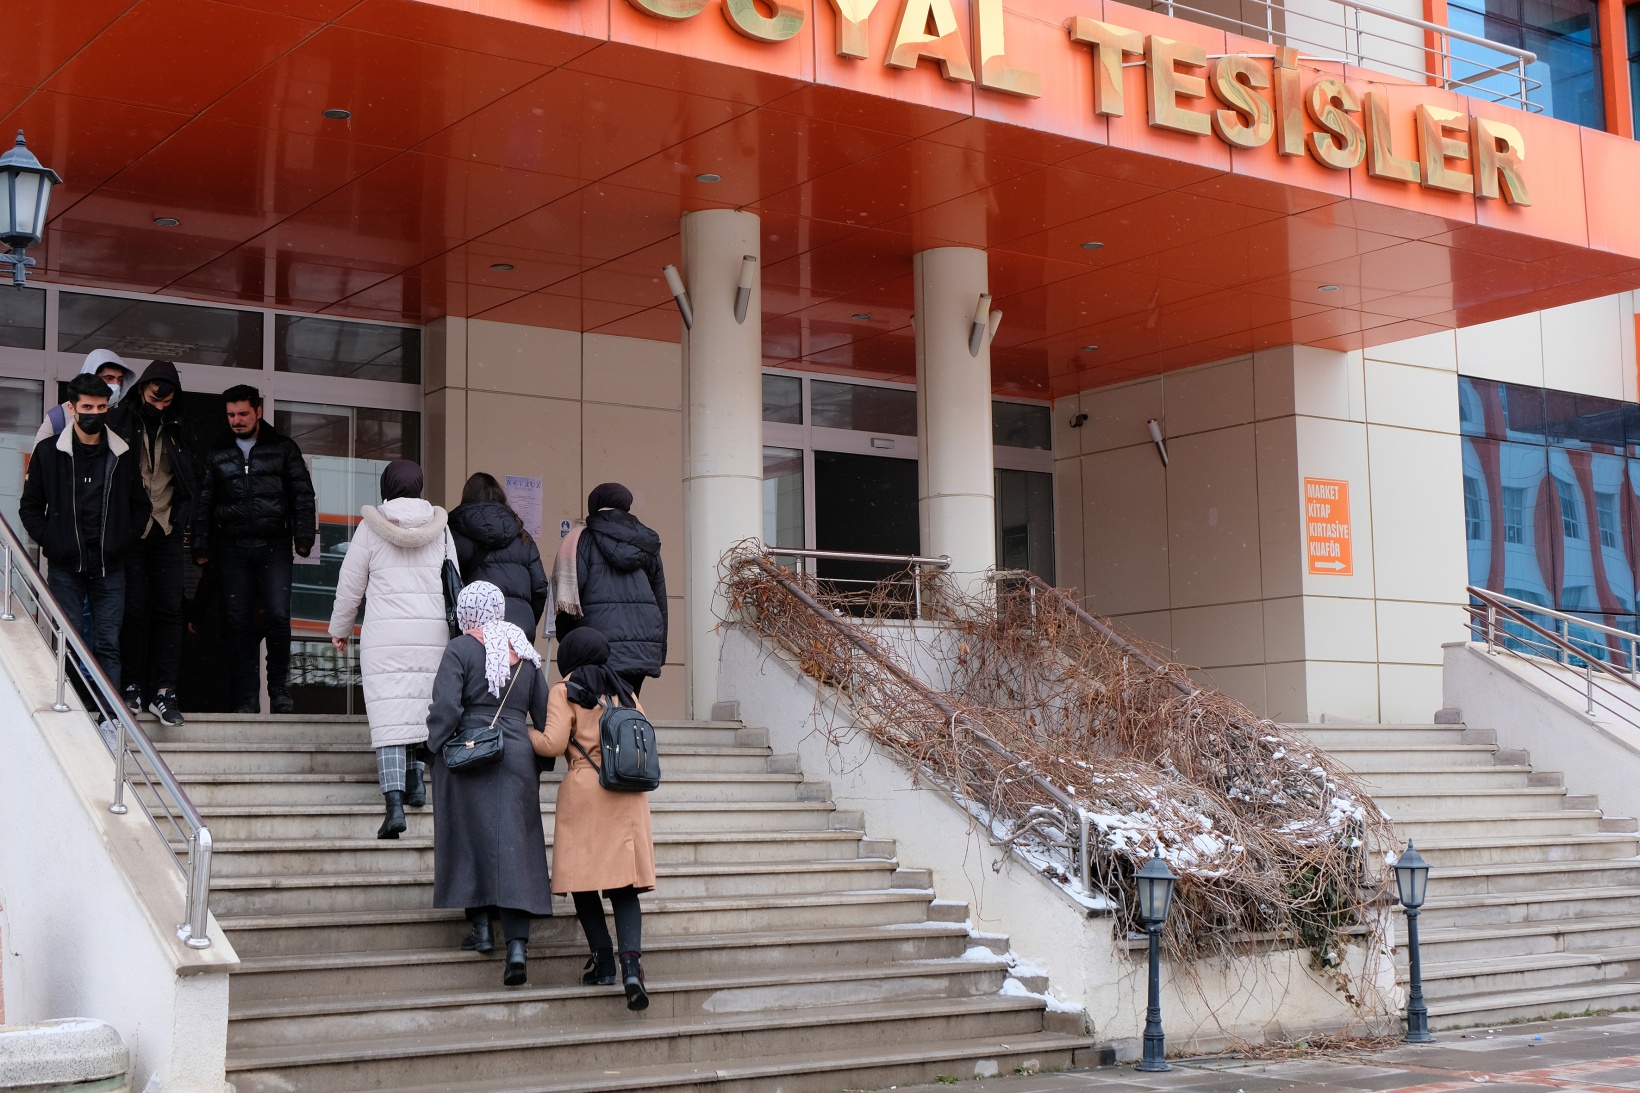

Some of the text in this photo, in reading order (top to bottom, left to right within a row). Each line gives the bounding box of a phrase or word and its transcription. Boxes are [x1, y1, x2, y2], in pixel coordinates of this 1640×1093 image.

[1070, 15, 1532, 207] TESİSLER
[1307, 483, 1339, 500] MARKET
[1308, 500, 1331, 518] KİTAP
[1309, 520, 1349, 539] KIRTASİYE
[1310, 540, 1341, 557] KUAFÖR
